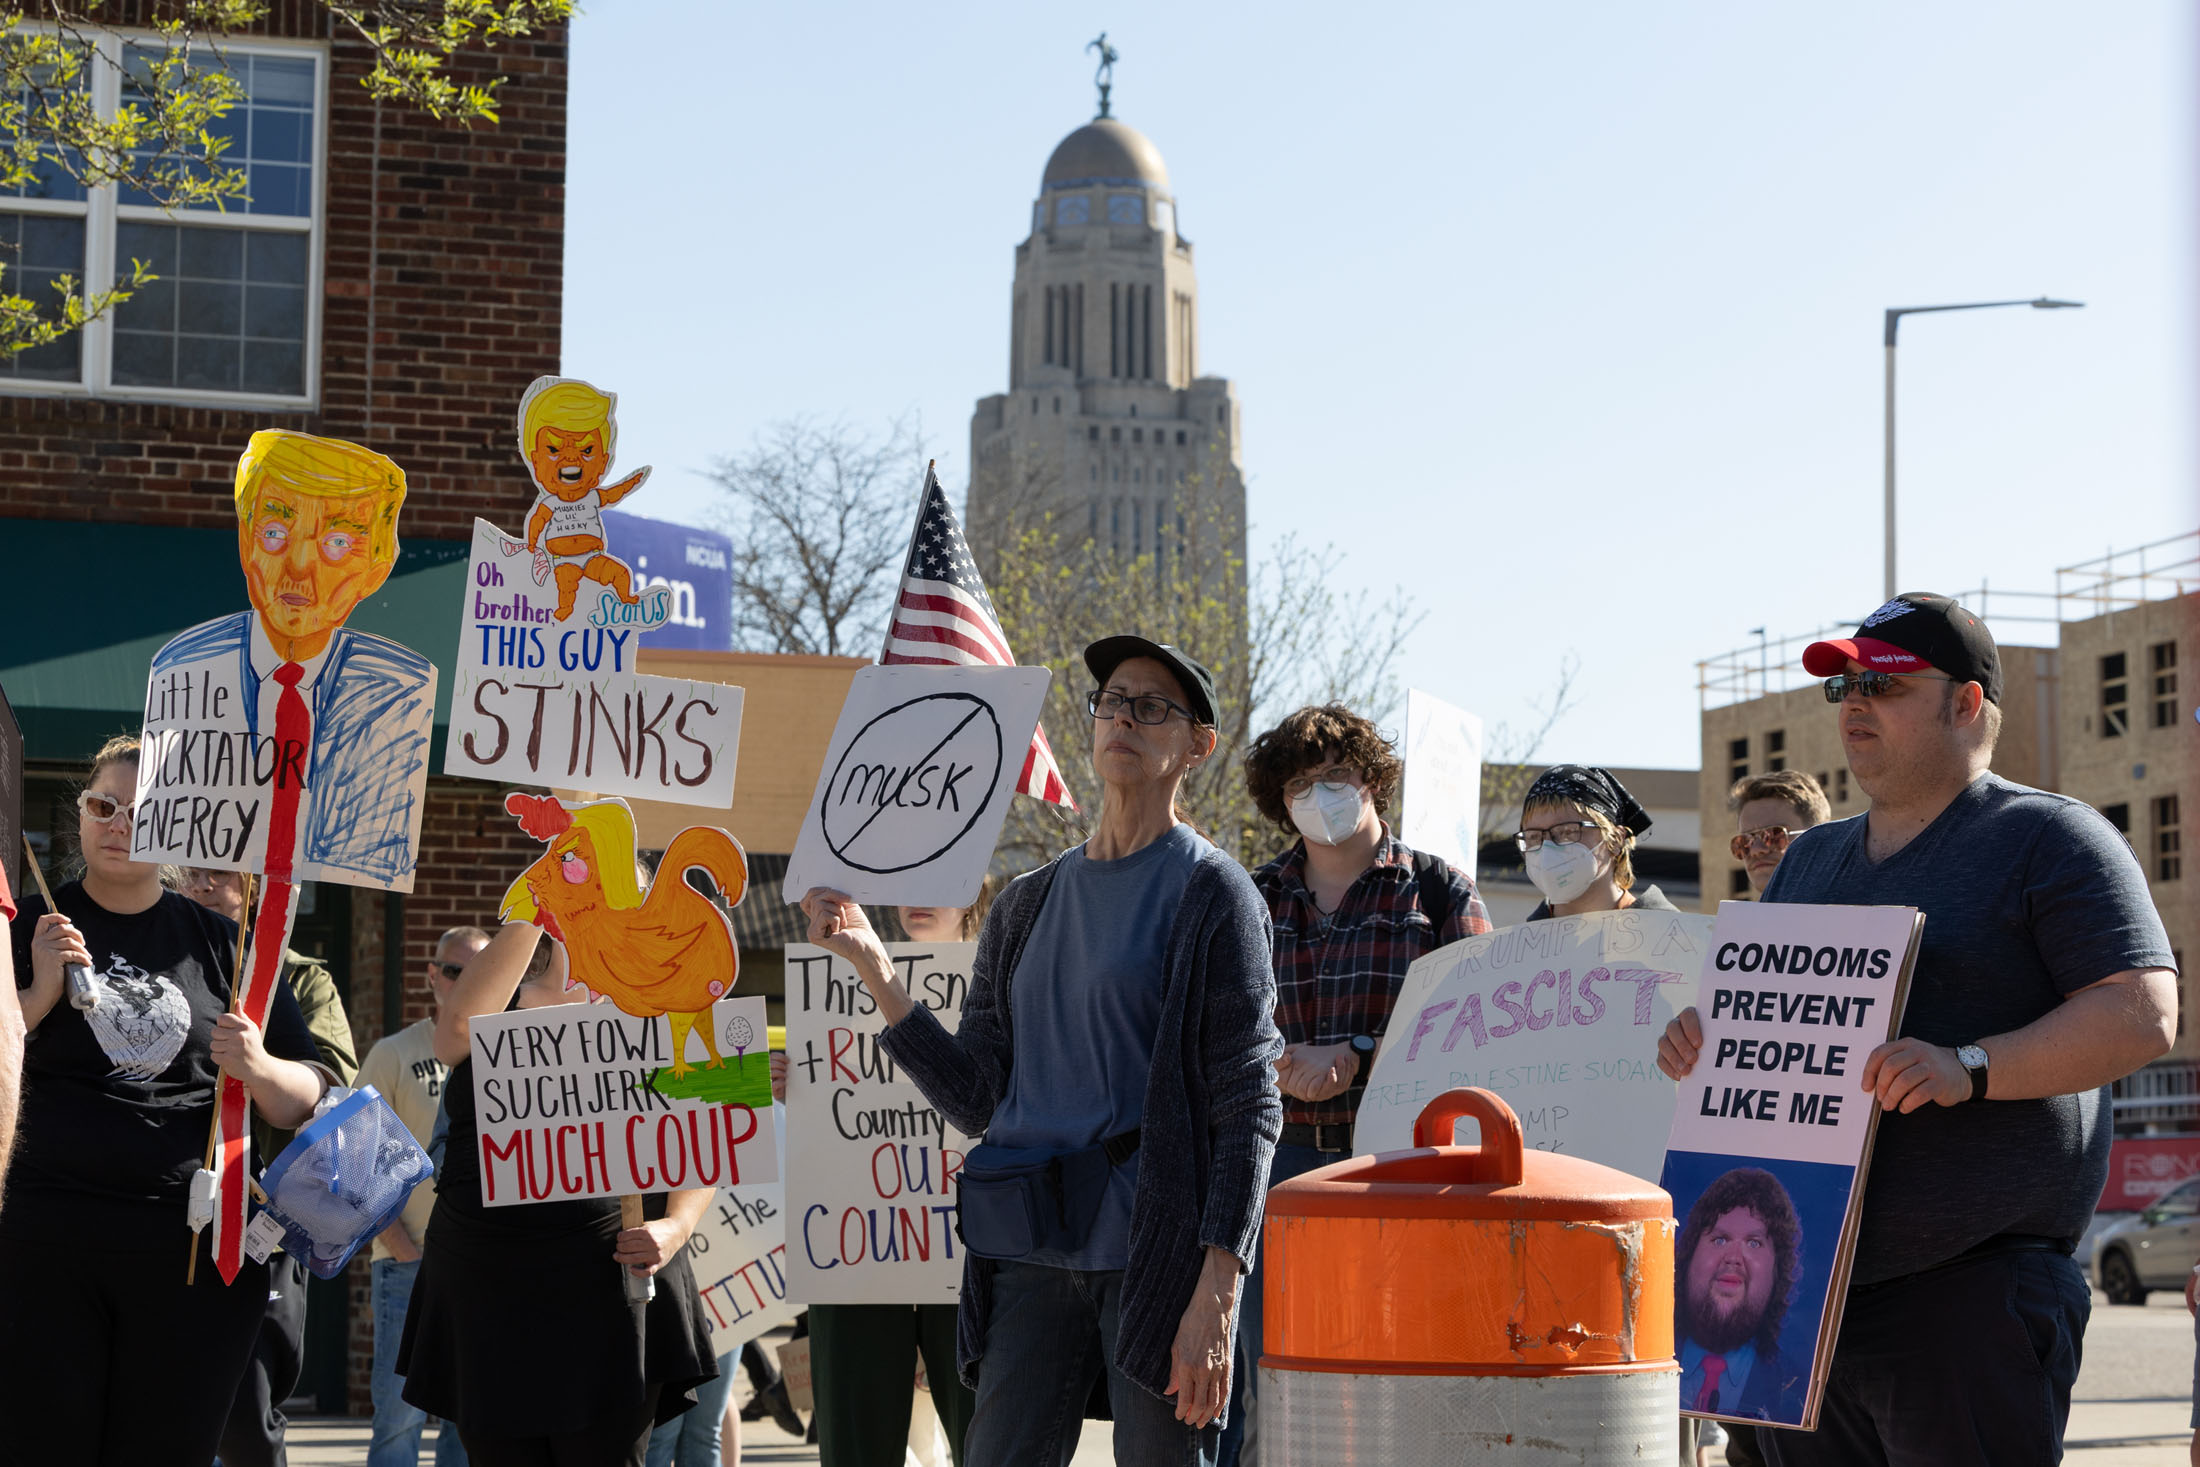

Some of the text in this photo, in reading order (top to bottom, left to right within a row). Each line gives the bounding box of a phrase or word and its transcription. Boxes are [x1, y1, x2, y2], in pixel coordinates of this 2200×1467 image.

[556, 522, 588, 532] HUSKY
[476, 561, 504, 587] Oh
[474, 590, 556, 627] brother,
[475, 624, 631, 673] THIS GUY
[147, 670, 229, 723] Little
[463, 678, 719, 787] STINKS
[140, 729, 306, 790] DICKTATOR
[135, 796, 260, 863] ENERGY
[1413, 912, 1698, 989] TRUMP IS A
[1715, 942, 1892, 979] CONDOMS
[788, 955, 877, 1017] This
[1711, 989, 1875, 1028] PREVENT
[1405, 967, 1688, 1063] FASCIST
[476, 1016, 669, 1069] VERY FOWL
[1714, 1038, 1849, 1077] PEOPLE
[483, 1067, 671, 1124] SUCH JERK
[1366, 1080, 1430, 1111] FREE
[1583, 1058, 1664, 1083] SUDAN
[1700, 1086, 1844, 1127] LIKE ME
[832, 1088, 945, 1150] Country
[481, 1103, 758, 1201] MUCH COUP
[872, 1142, 965, 1199] OUR
[718, 1191, 777, 1236] the
[803, 1204, 958, 1270] COUNT
